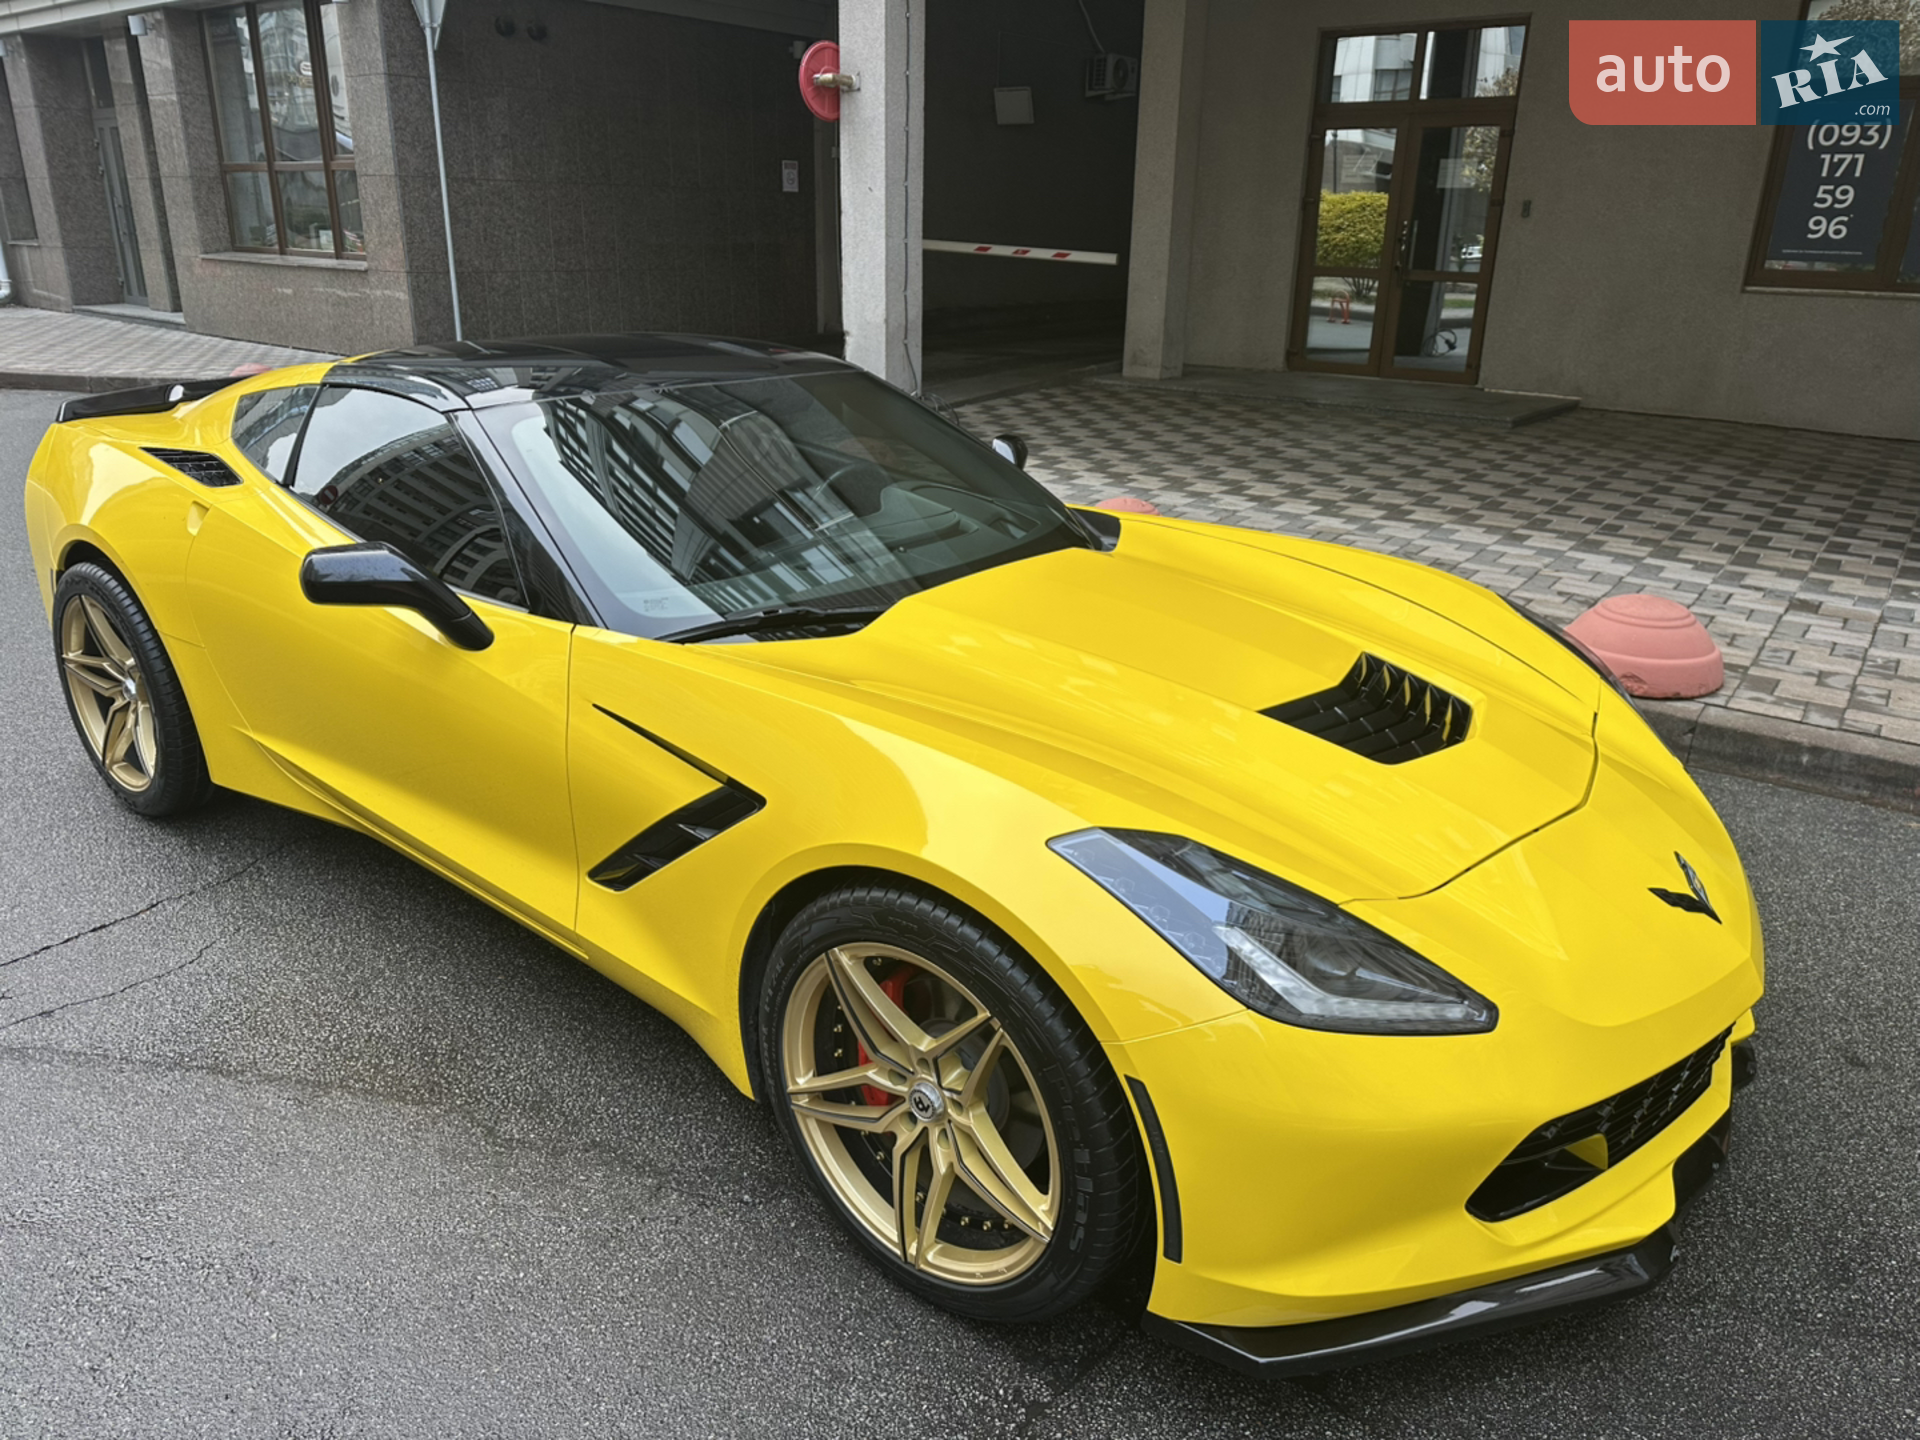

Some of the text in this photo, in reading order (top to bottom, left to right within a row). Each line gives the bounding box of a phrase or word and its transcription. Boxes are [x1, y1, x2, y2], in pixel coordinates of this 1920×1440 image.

[1807, 118, 1893, 150] (093)
[1820, 153, 1865, 178] 171
[1812, 184, 1855, 209] 59
[1806, 215, 1849, 239] 96
